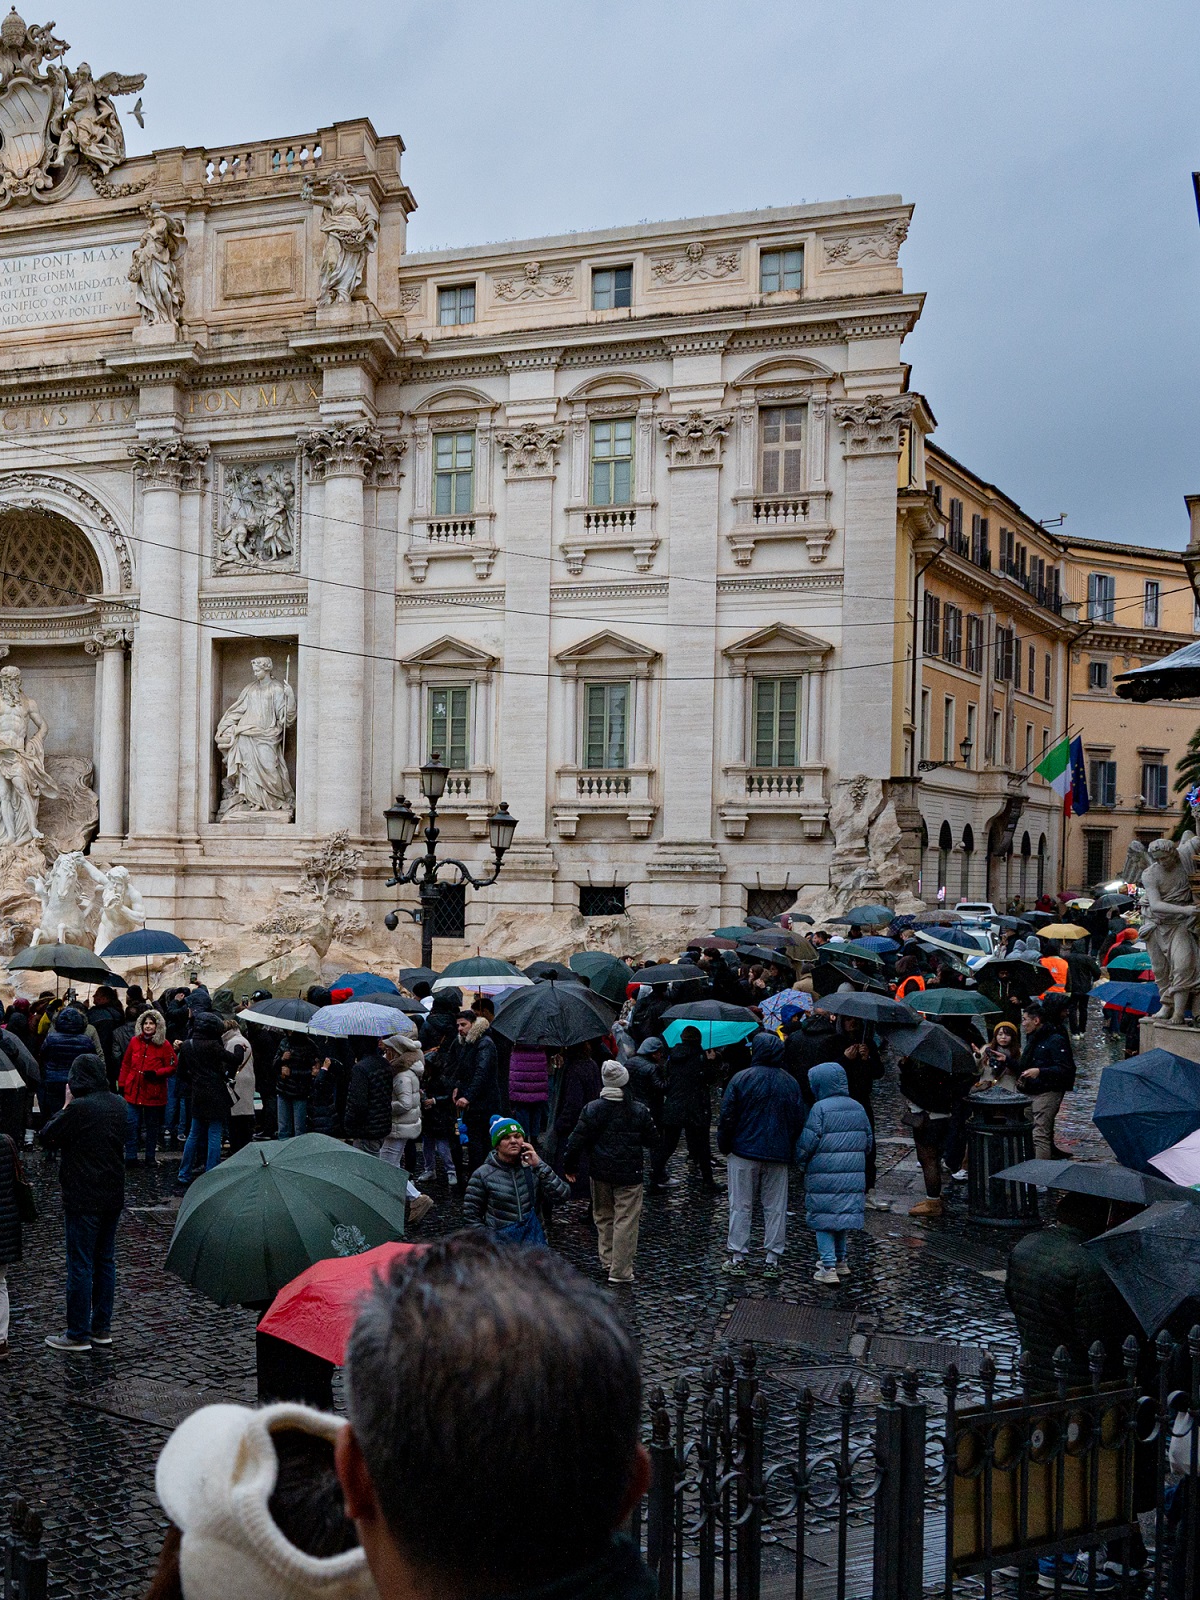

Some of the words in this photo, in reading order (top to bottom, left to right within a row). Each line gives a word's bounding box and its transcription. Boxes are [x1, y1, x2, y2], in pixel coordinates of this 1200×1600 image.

[19, 268, 75, 284] VIRGINEM
[44, 276, 129, 294] COMMENDATAM
[53, 291, 104, 306] ORNAVIT
[88, 400, 137, 424] XIV
[256, 381, 320, 408] MAX
